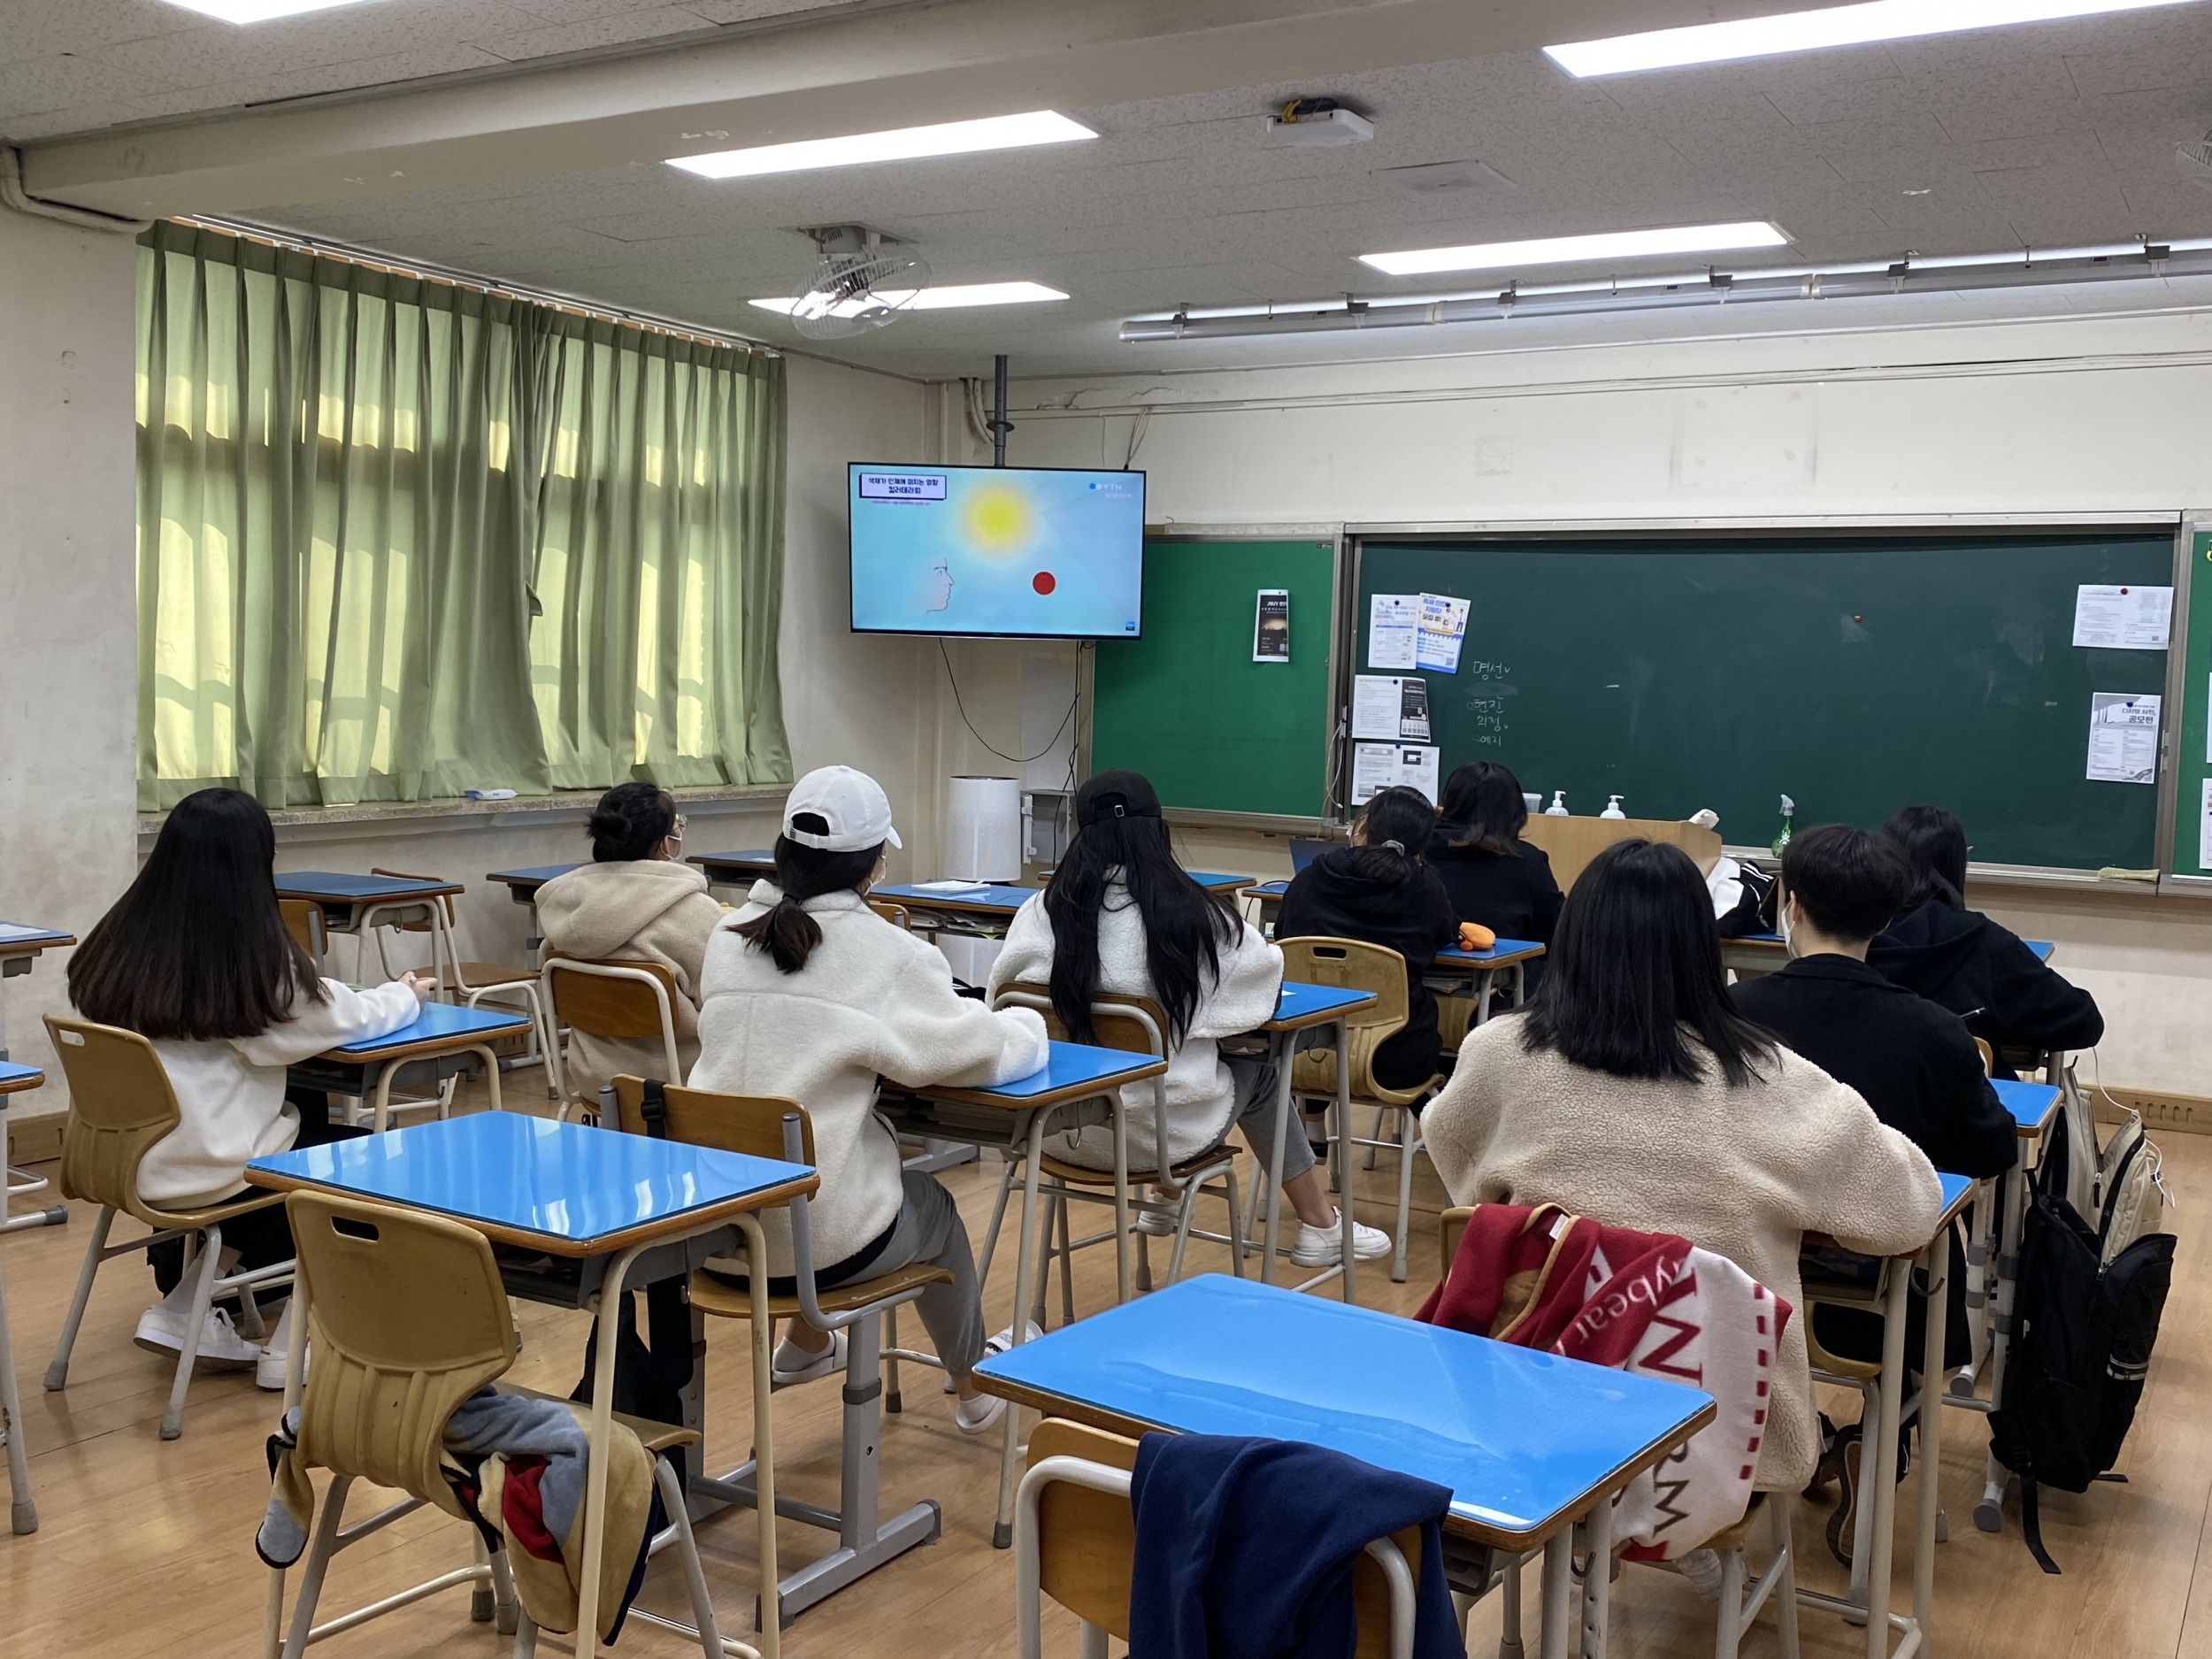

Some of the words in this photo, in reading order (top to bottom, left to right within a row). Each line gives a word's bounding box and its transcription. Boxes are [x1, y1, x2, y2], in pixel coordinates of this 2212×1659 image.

[1473, 661, 1503, 680] 명선
[2129, 715, 2154, 724] 공모전
[1572, 1255, 1685, 1345] ybear
